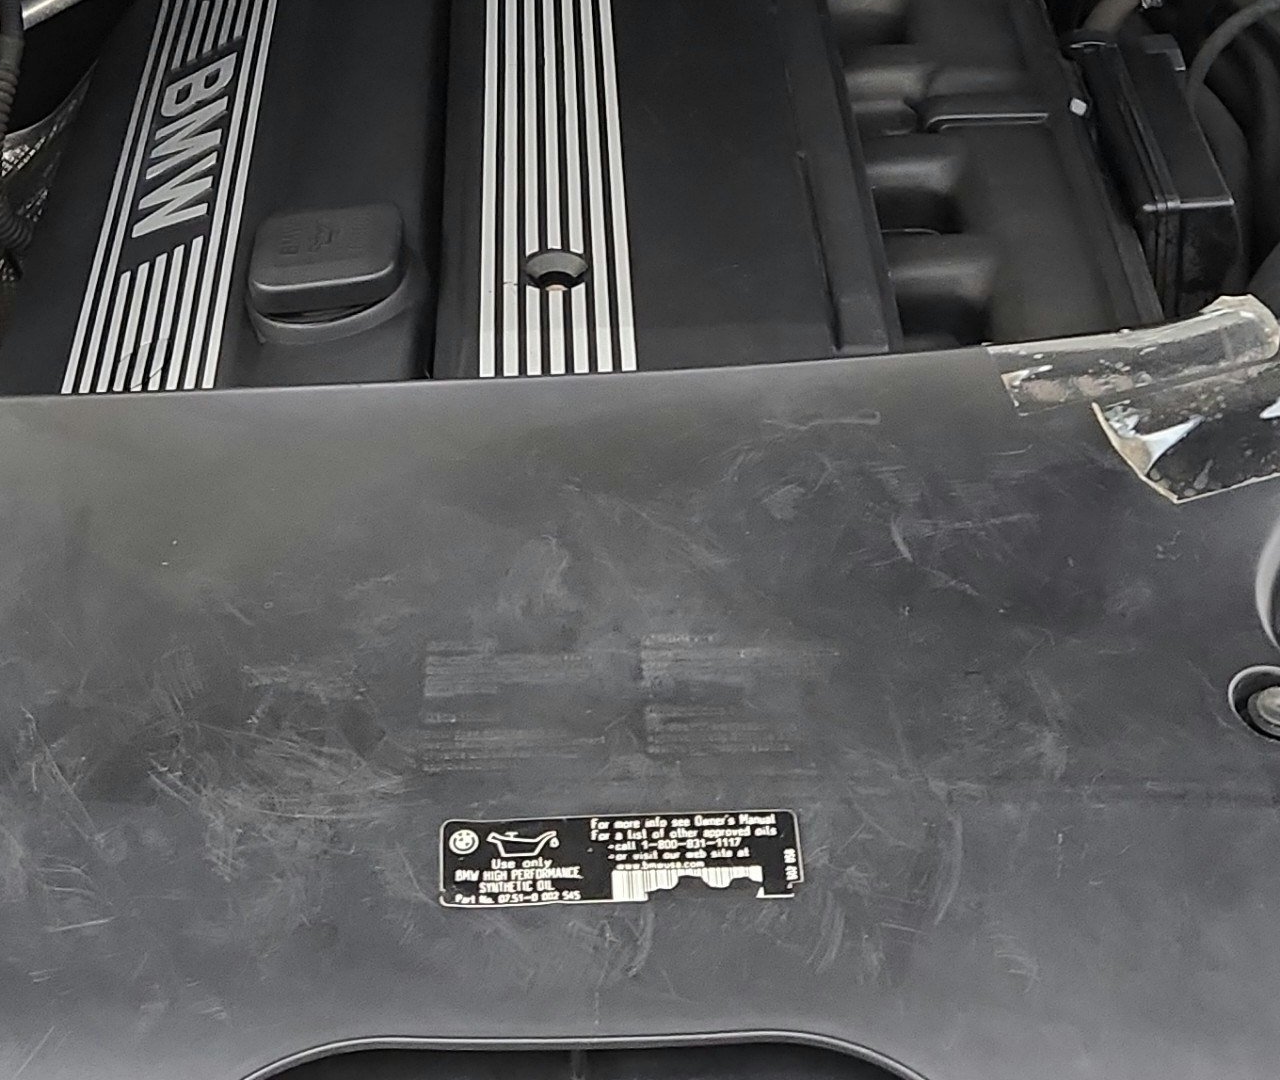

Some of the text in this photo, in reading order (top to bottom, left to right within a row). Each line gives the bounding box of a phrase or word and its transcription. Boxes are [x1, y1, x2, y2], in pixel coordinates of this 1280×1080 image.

[131, 52, 238, 238] BMW
[614, 820, 640, 828] more
[645, 817, 667, 828] info
[671, 819, 690, 827] see
[694, 815, 735, 826] Owner's
[739, 814, 776, 825] Manual
[615, 832, 623, 840] a
[627, 828, 647, 839] list
[652, 828, 664, 838] of
[669, 828, 698, 838] other
[703, 826, 750, 838] approved
[755, 827, 777, 836] oils
[641, 838, 741, 849] 1-800-831-1117
[632, 850, 658, 860] visit
[685, 850, 707, 858] web
[710, 849, 733, 858] site
[737, 848, 750, 857] at
[491, 857, 553, 869] Use only
[616, 861, 705, 869] www.bmwusa.com
[455, 866, 581, 881] BMW HIGH PERFORMANCE
[479, 880, 555, 893] SYNTHETIC OIL
[455, 894, 476, 904] Part
